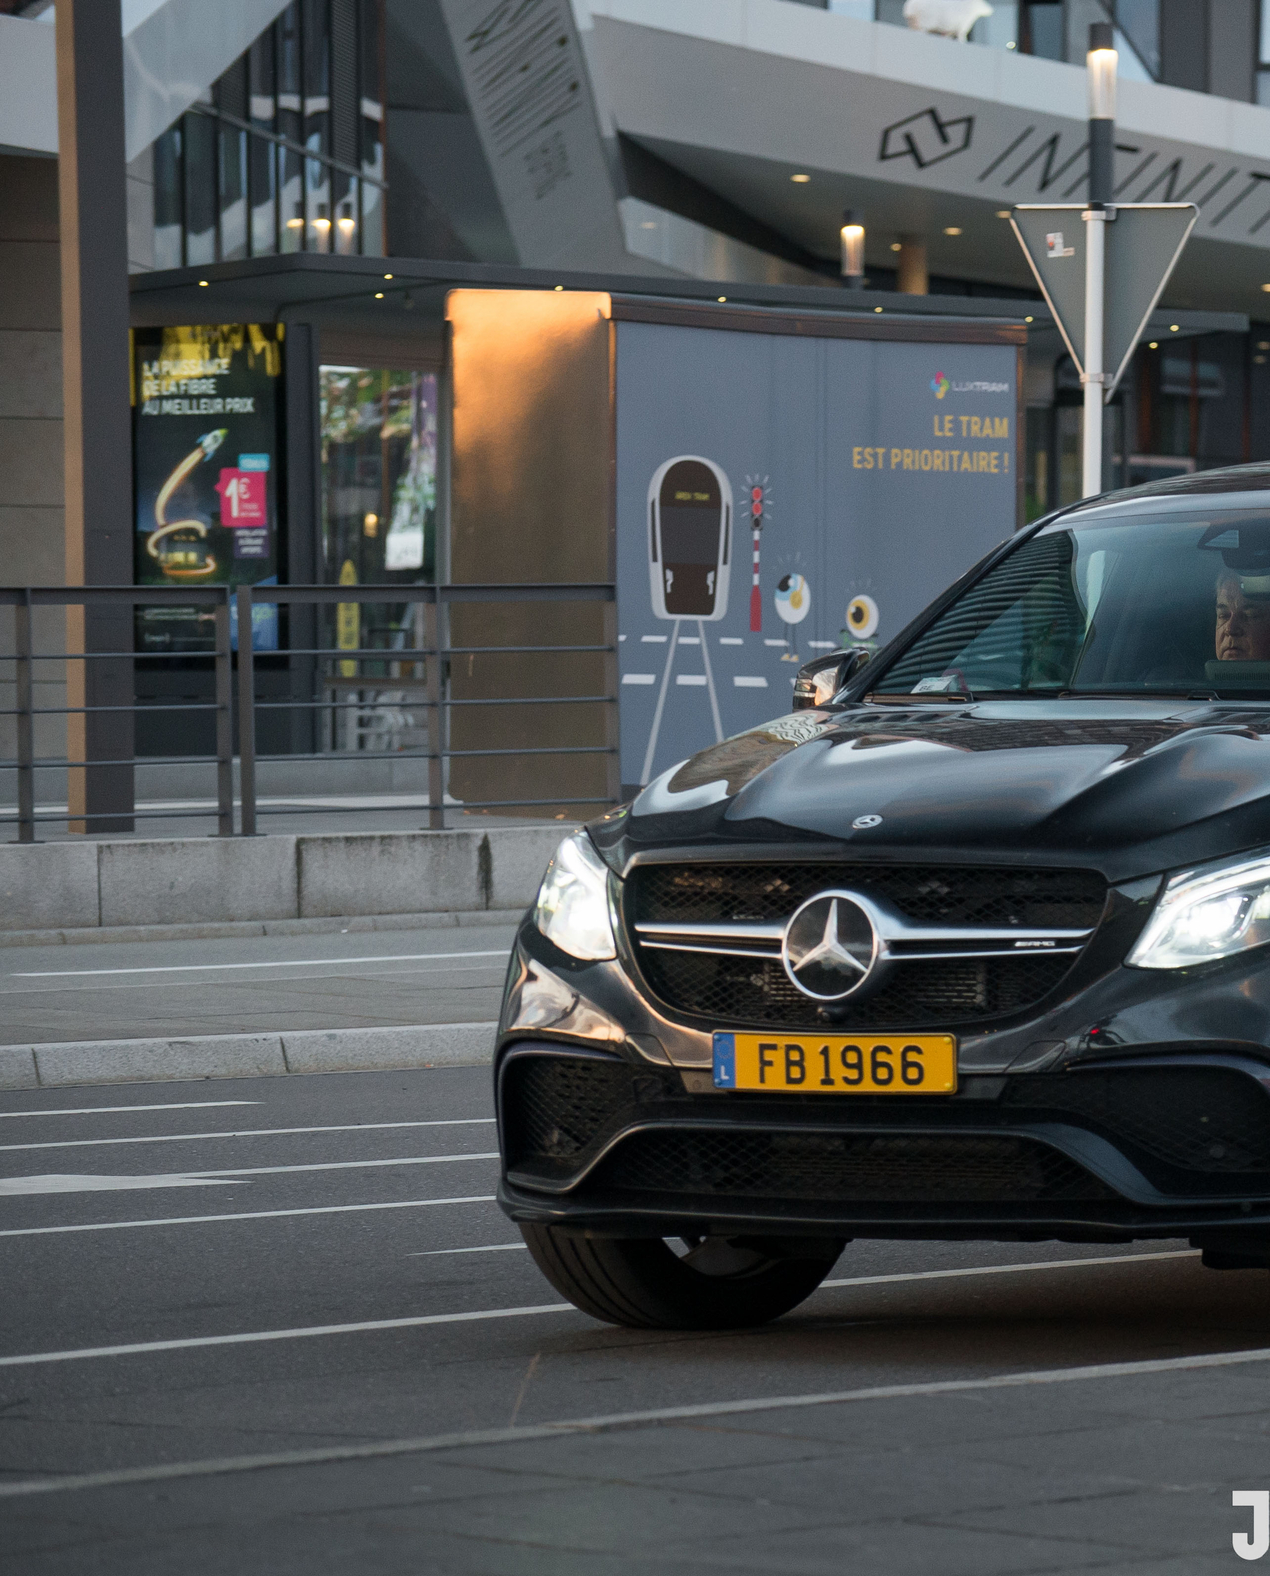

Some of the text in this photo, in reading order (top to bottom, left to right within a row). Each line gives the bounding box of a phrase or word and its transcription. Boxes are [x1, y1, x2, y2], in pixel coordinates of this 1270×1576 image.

[162, 379, 178, 396] LA
[179, 378, 217, 394] FIBRE
[142, 397, 255, 415] AU MEILLEUR PRIX
[933, 415, 1009, 438] LE TRAM
[852, 446, 886, 469] EST
[890, 448, 999, 473] PRIORITAIRE
[720, 1065, 730, 1080] L
